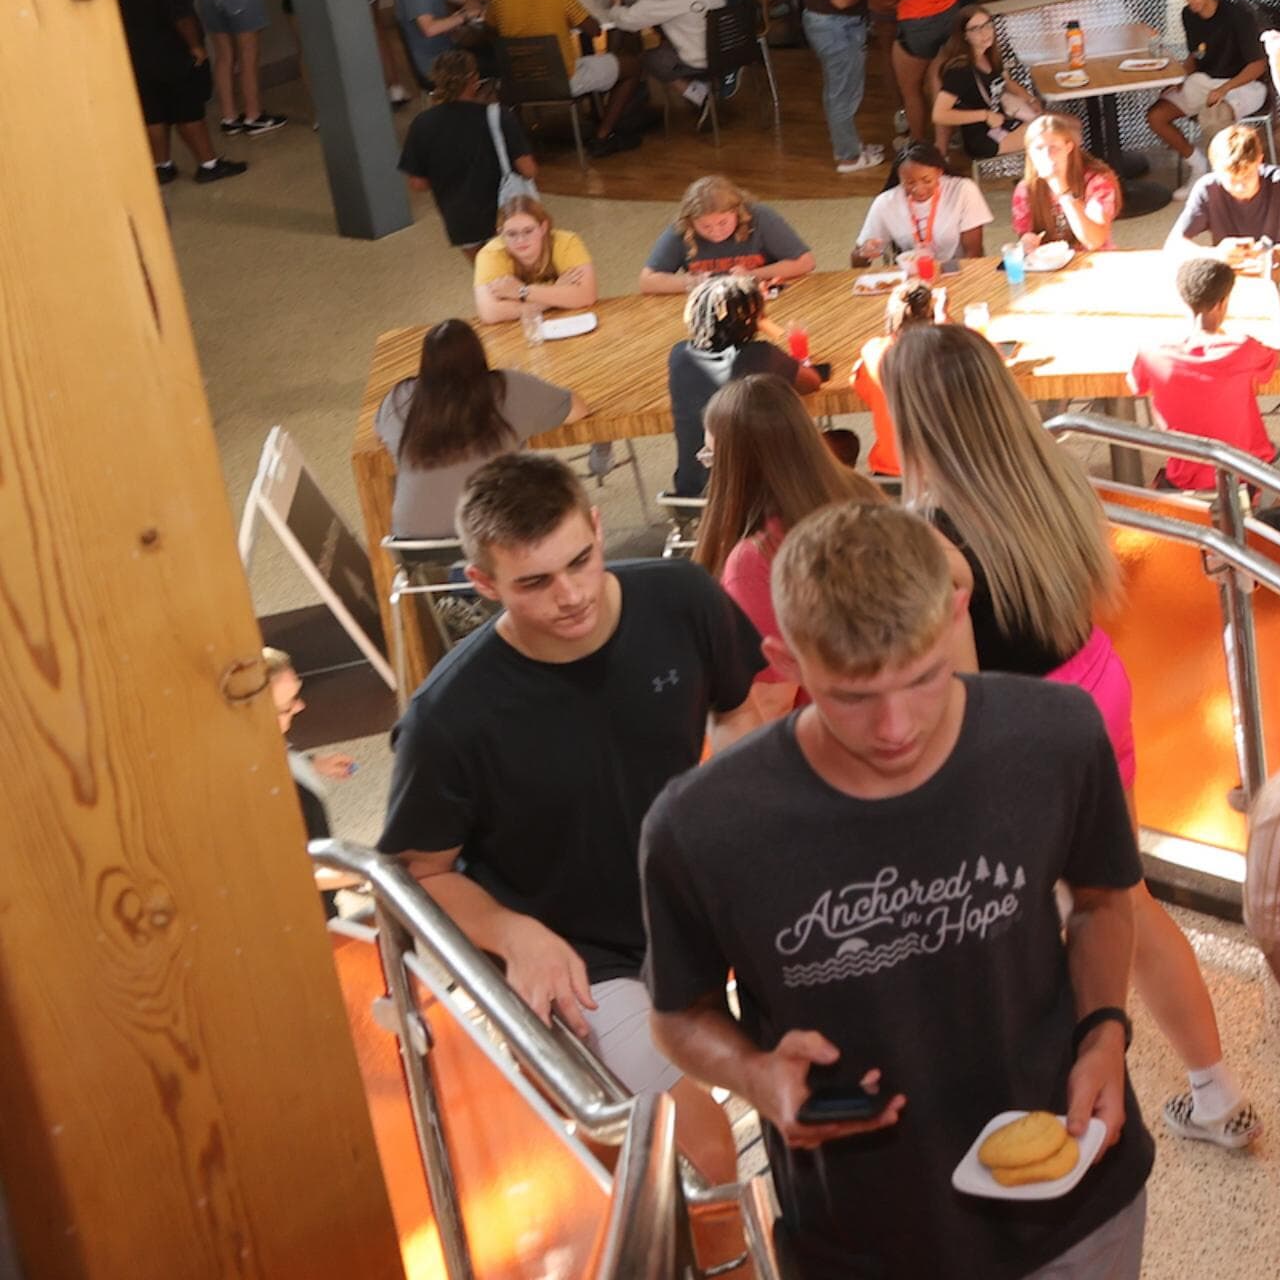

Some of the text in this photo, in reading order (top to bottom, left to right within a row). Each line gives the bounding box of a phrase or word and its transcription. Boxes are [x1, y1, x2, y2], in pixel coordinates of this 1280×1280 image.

[774, 859, 973, 956] Anchored
[900, 892, 1020, 955] in Hope
